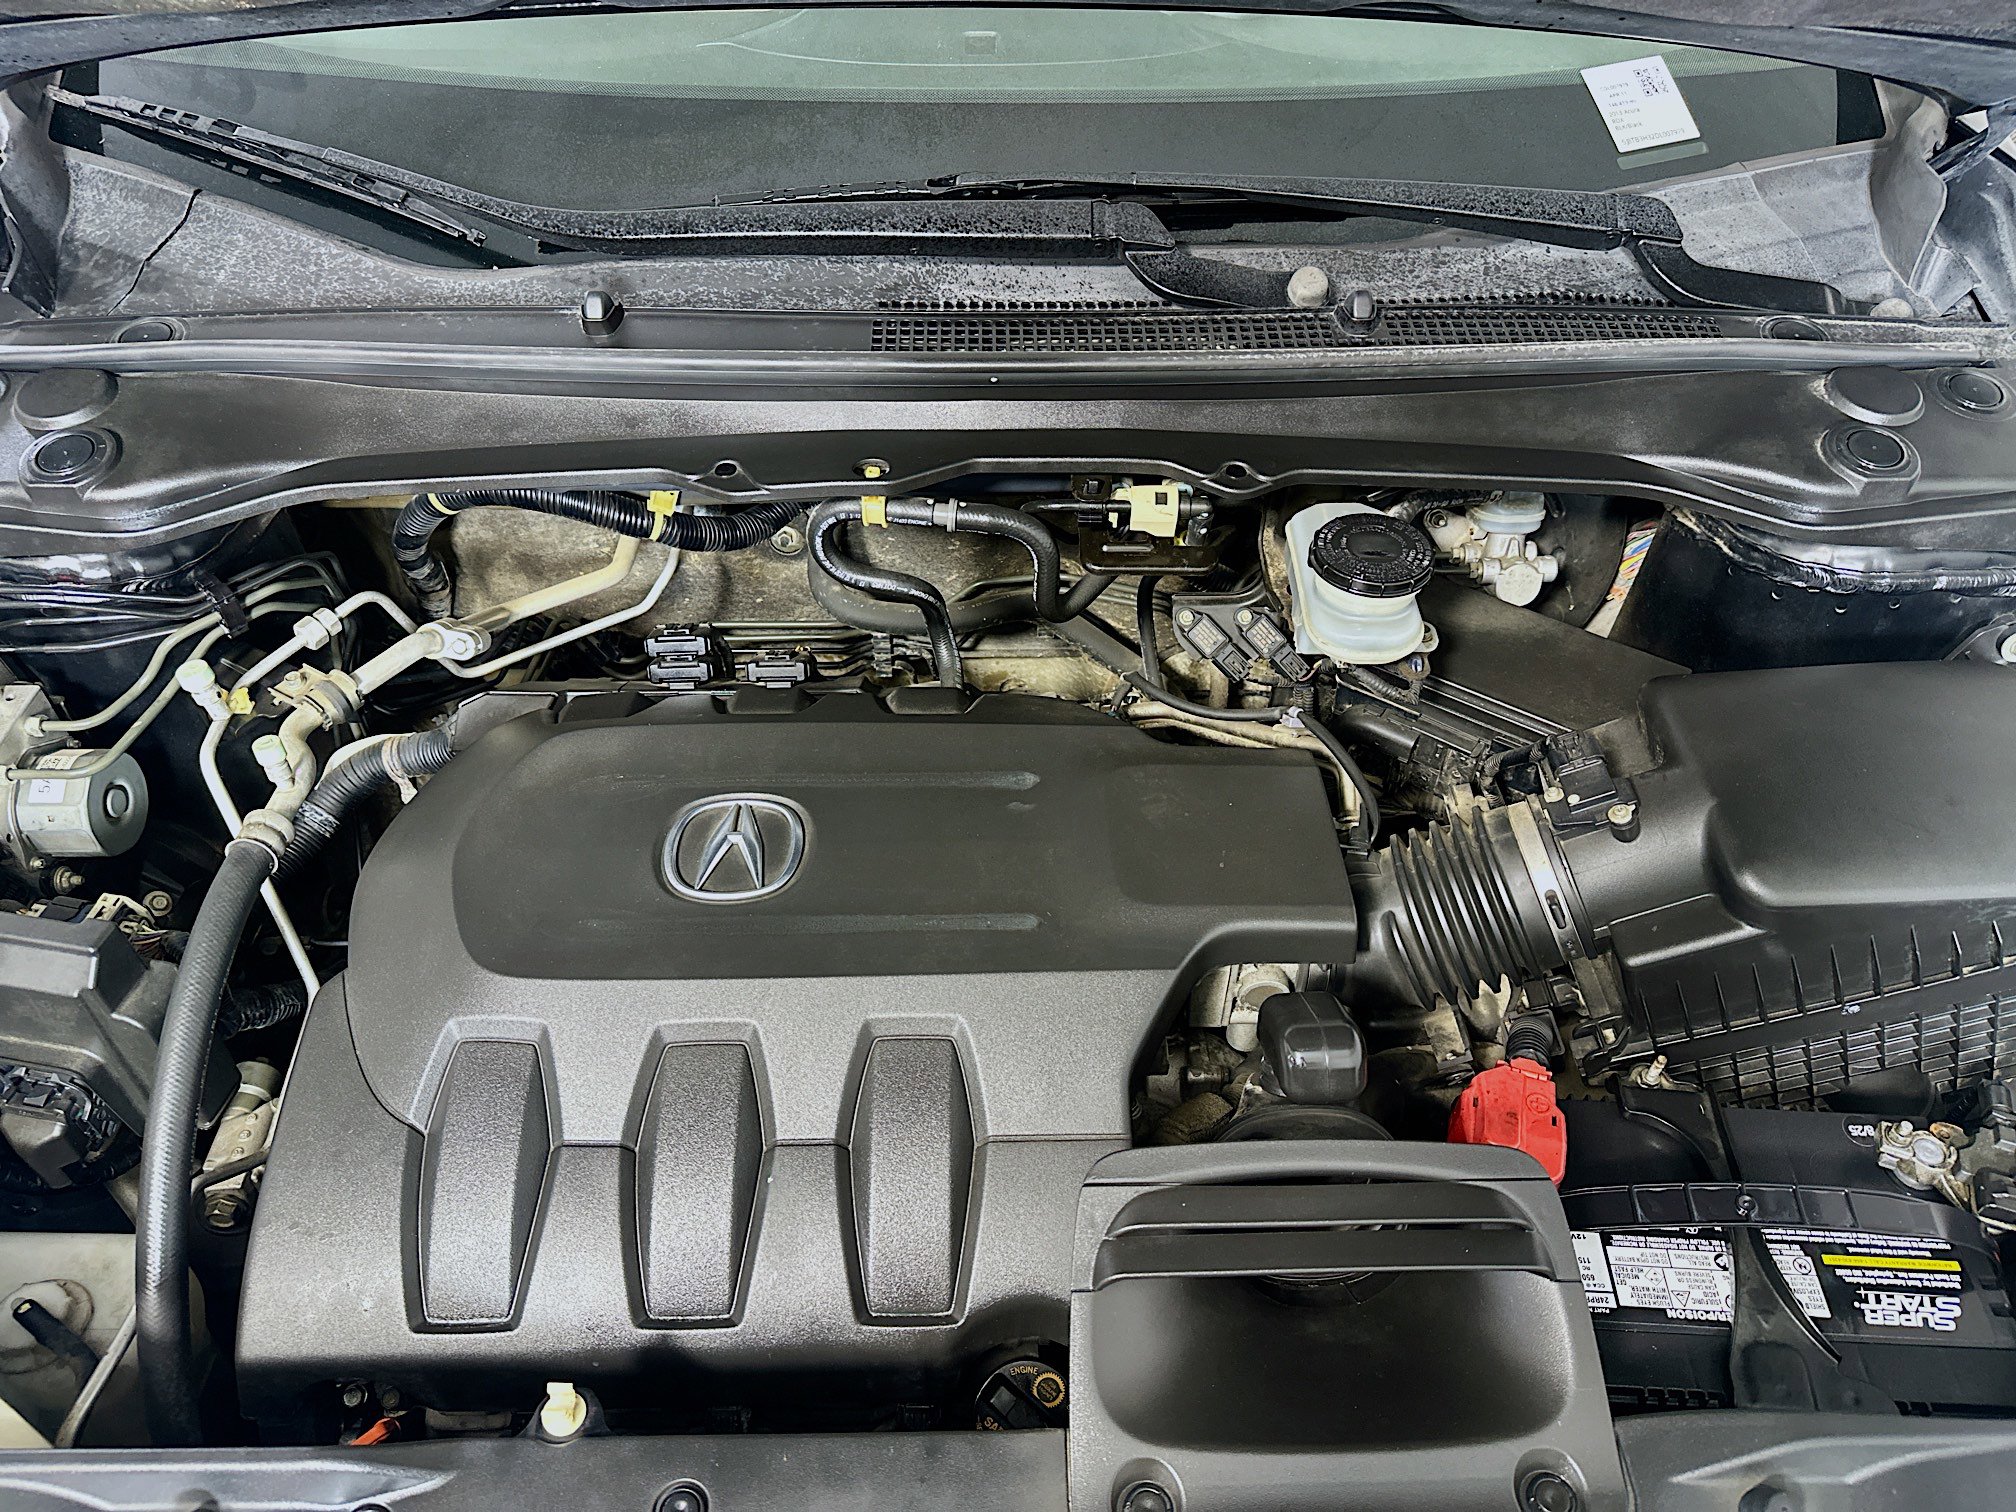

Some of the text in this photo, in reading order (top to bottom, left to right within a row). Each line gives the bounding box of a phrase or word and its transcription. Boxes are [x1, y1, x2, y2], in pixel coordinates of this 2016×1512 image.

[1792, 1287, 1820, 1295] EXPLOSIV
[1860, 1293, 1962, 1318] START
[1863, 1309, 1956, 1331] SUPER
[1009, 1366, 1039, 1376] ENGINE
